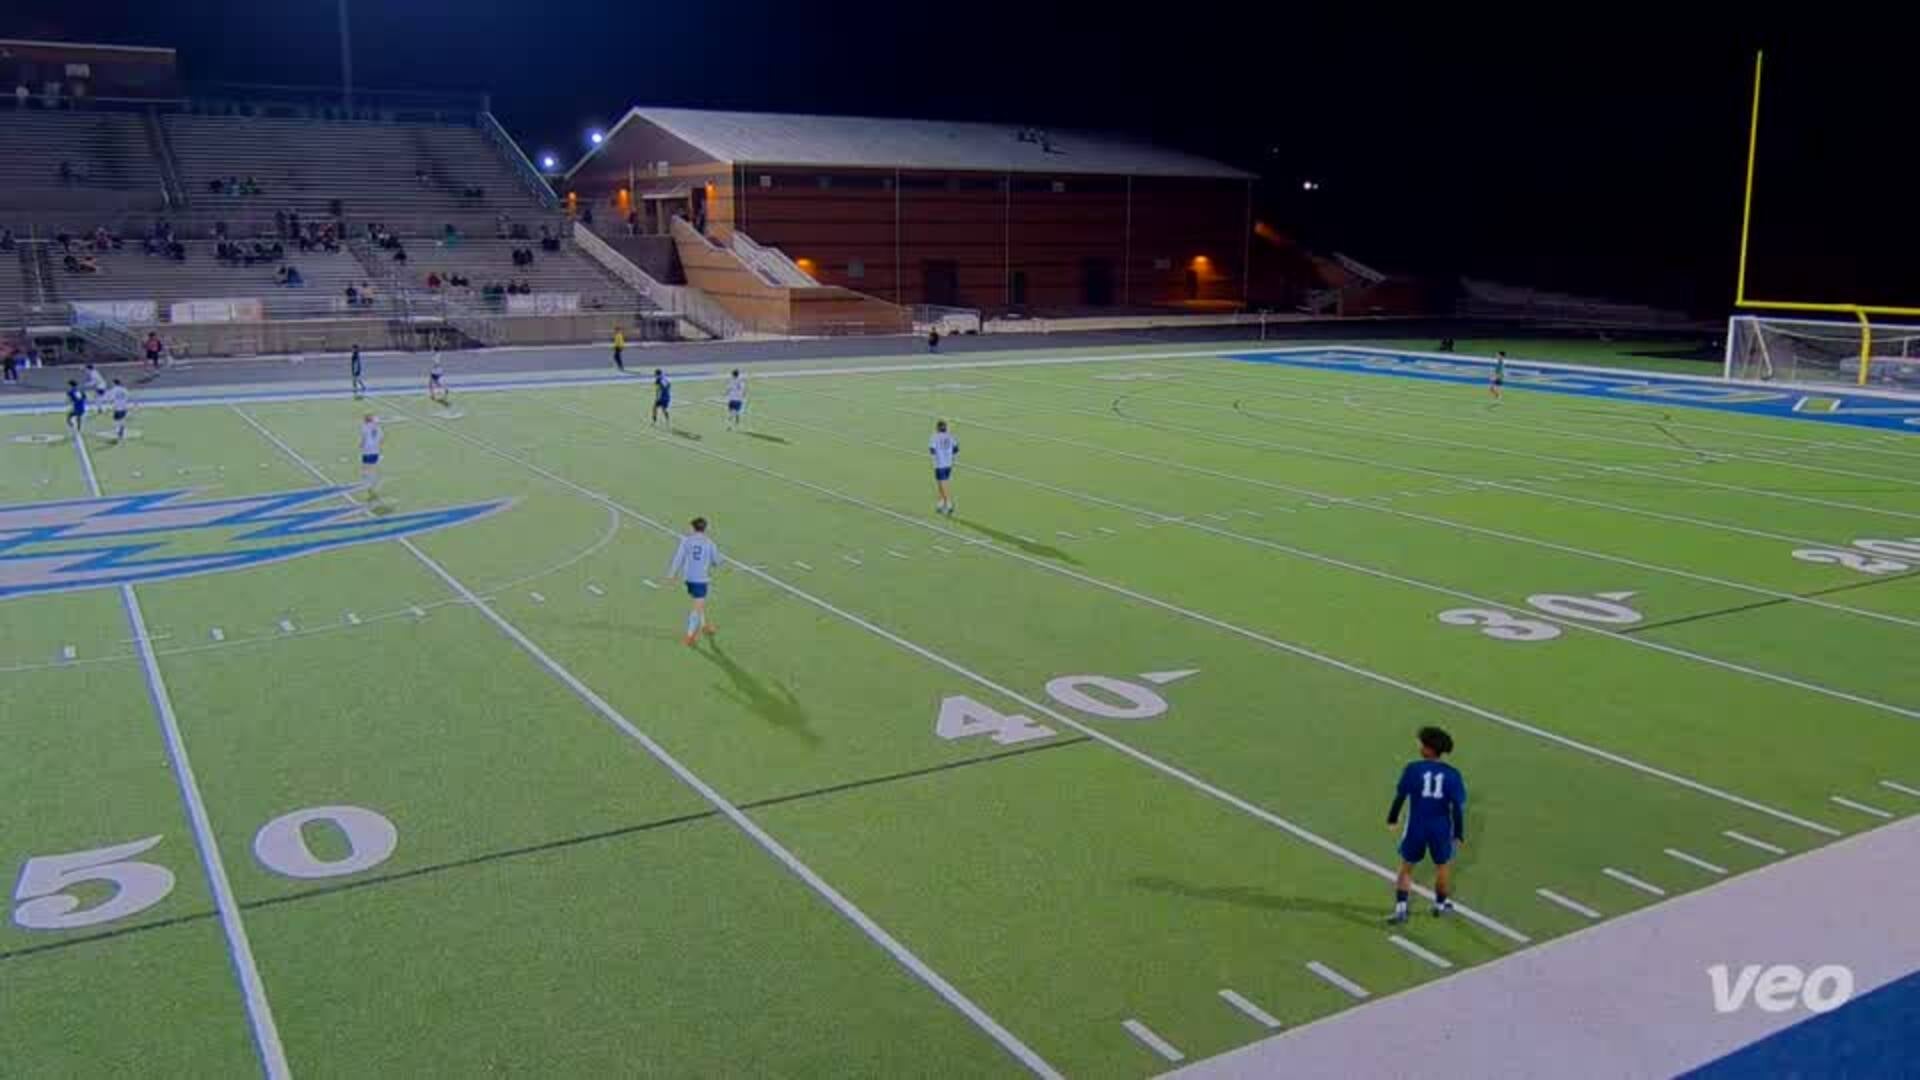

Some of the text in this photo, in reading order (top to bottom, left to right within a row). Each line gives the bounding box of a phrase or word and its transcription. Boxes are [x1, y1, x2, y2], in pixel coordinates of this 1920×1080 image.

[692, 545, 702, 561] 2
[1438, 593, 1643, 641] 30
[936, 675, 1169, 745] 40
[1421, 770, 1444, 799] 11
[13, 805, 398, 930] 50
